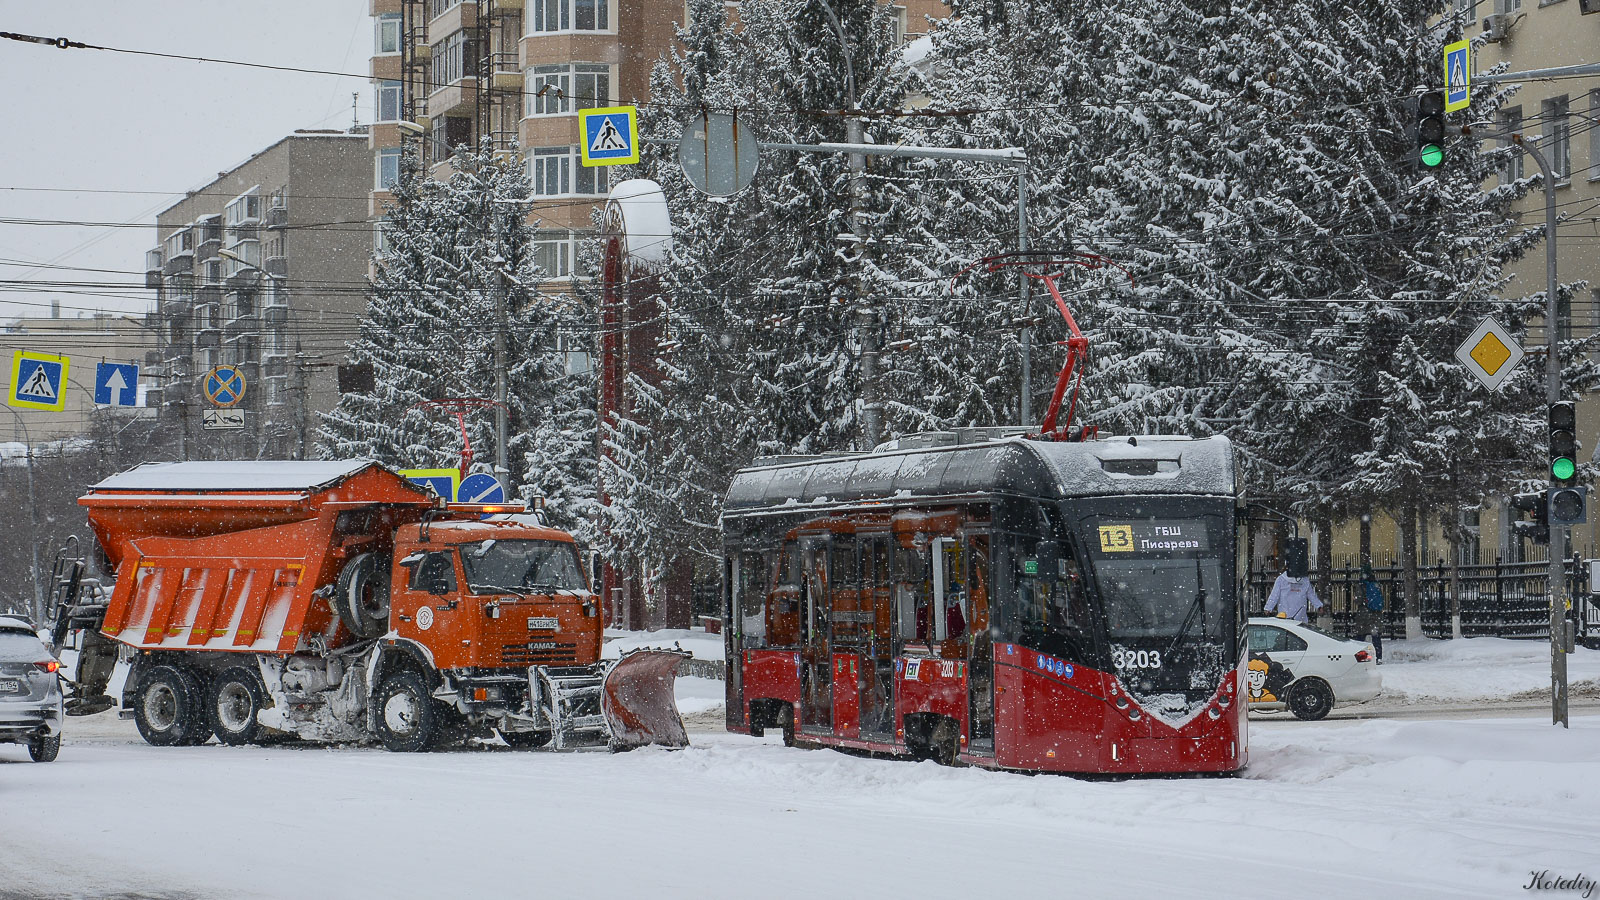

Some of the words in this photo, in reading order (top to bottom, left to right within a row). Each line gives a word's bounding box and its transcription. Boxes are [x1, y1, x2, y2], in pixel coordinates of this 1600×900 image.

[1155, 526, 1182, 536] ГБШ
[1102, 530, 1129, 546] 13
[1141, 539, 1199, 550] Писарева
[527, 642, 556, 650] KAMAZ
[1113, 650, 1161, 669] 3203
